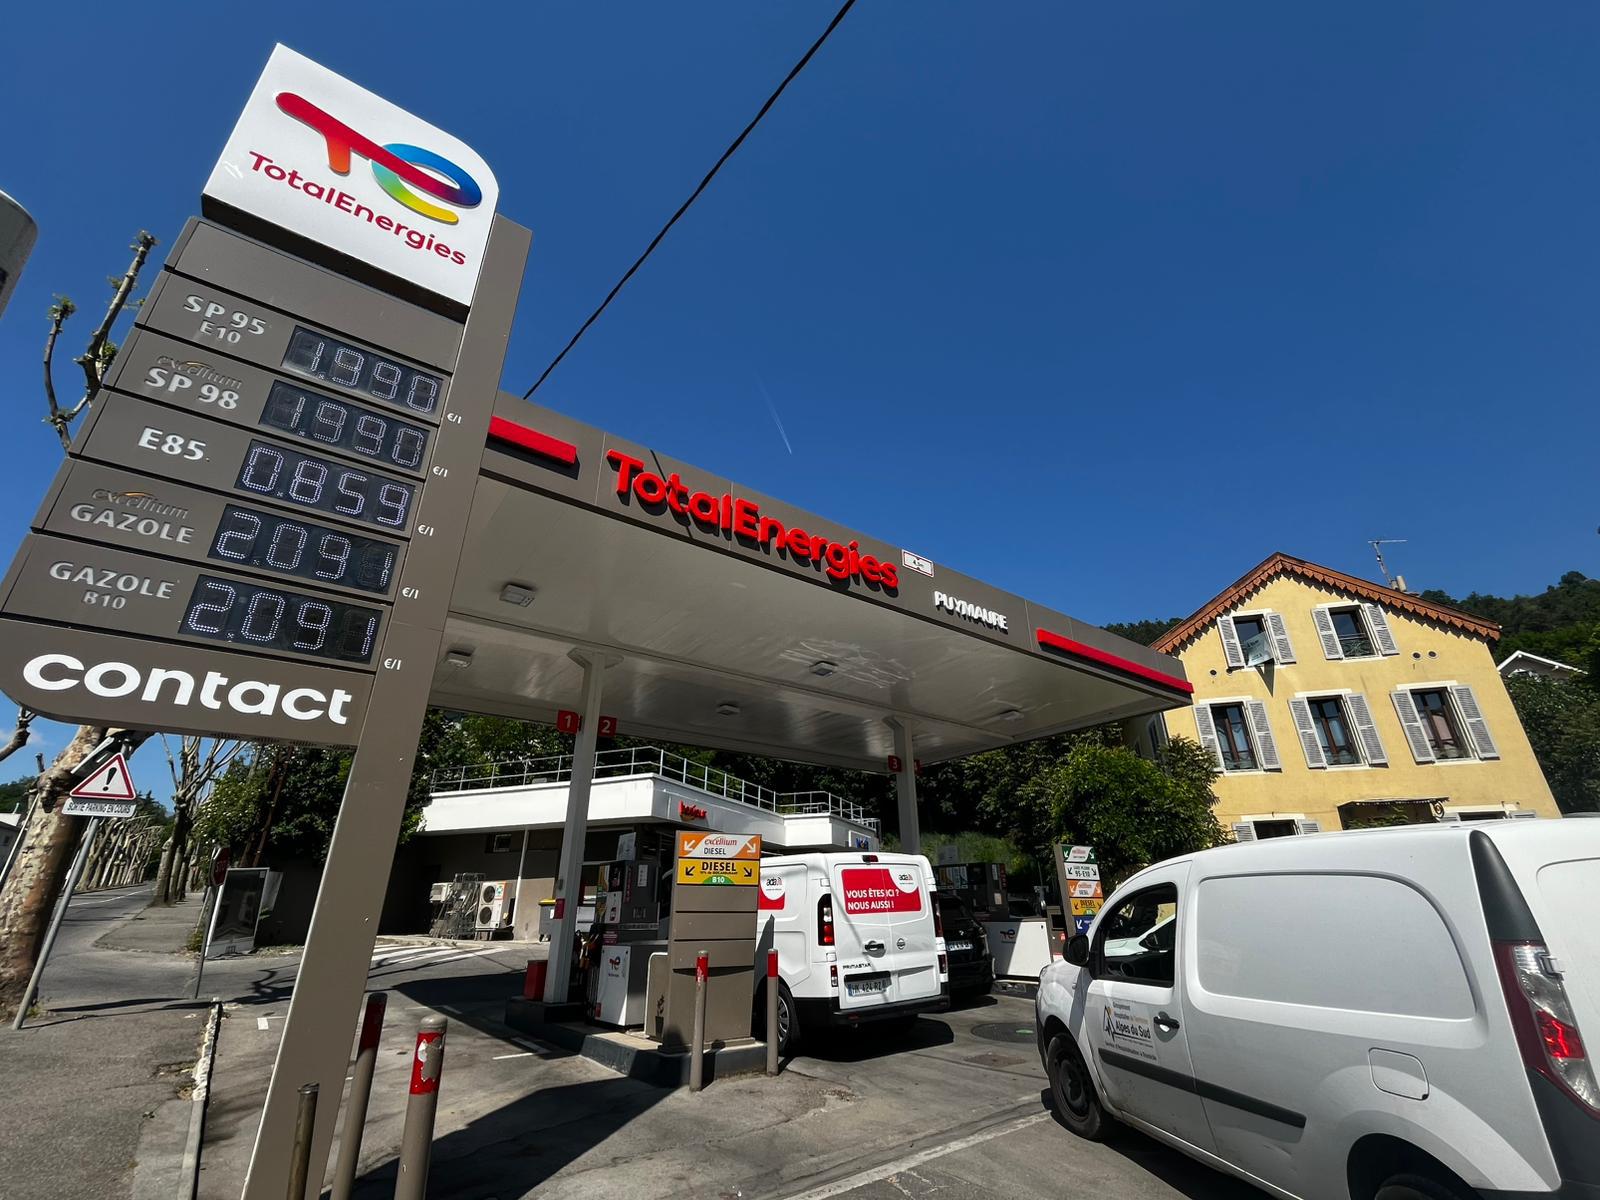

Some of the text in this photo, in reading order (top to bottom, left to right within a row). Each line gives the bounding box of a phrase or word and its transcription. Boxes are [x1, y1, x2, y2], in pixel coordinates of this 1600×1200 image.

[248, 151, 466, 265] TotalEnergies
[183, 294, 266, 336] SP 95
[199, 320, 241, 344] E10
[144, 367, 240, 410] SP 98
[157, 355, 242, 389] excellium
[137, 426, 206, 461] E85
[242, 446, 409, 526] 0.859
[91, 487, 189, 520] excellium
[606, 449, 899, 589] TotalEnergies
[69, 502, 195, 545] GAZOLE
[216, 511, 393, 588] 2.091
[49, 561, 175, 600] GAZOLE
[82, 589, 126, 611] B10
[934, 590, 1008, 630] PUYMAURE
[187, 582, 376, 657] 2.091
[22, 653, 353, 725] contact
[565, 714, 572, 728] 1
[601, 720, 610, 733] 2
[703, 848, 727, 856] DIESEL
[704, 836, 738, 846] excellium
[702, 861, 737, 872] DIESEL
[711, 876, 726, 884] B10
[846, 889, 868, 898] VOUS
[868, 887, 886, 898] ÊTES
[886, 889, 895, 897] ICI
[847, 901, 870, 910] NOUS
[870, 900, 890, 909] AUSSI
[842, 962, 872, 970] PRIMASTAR
[1115, 1020, 1131, 1034] Alpes
[1131, 1024, 1138, 1037] du
[1138, 1025, 1151, 1039] Sud
